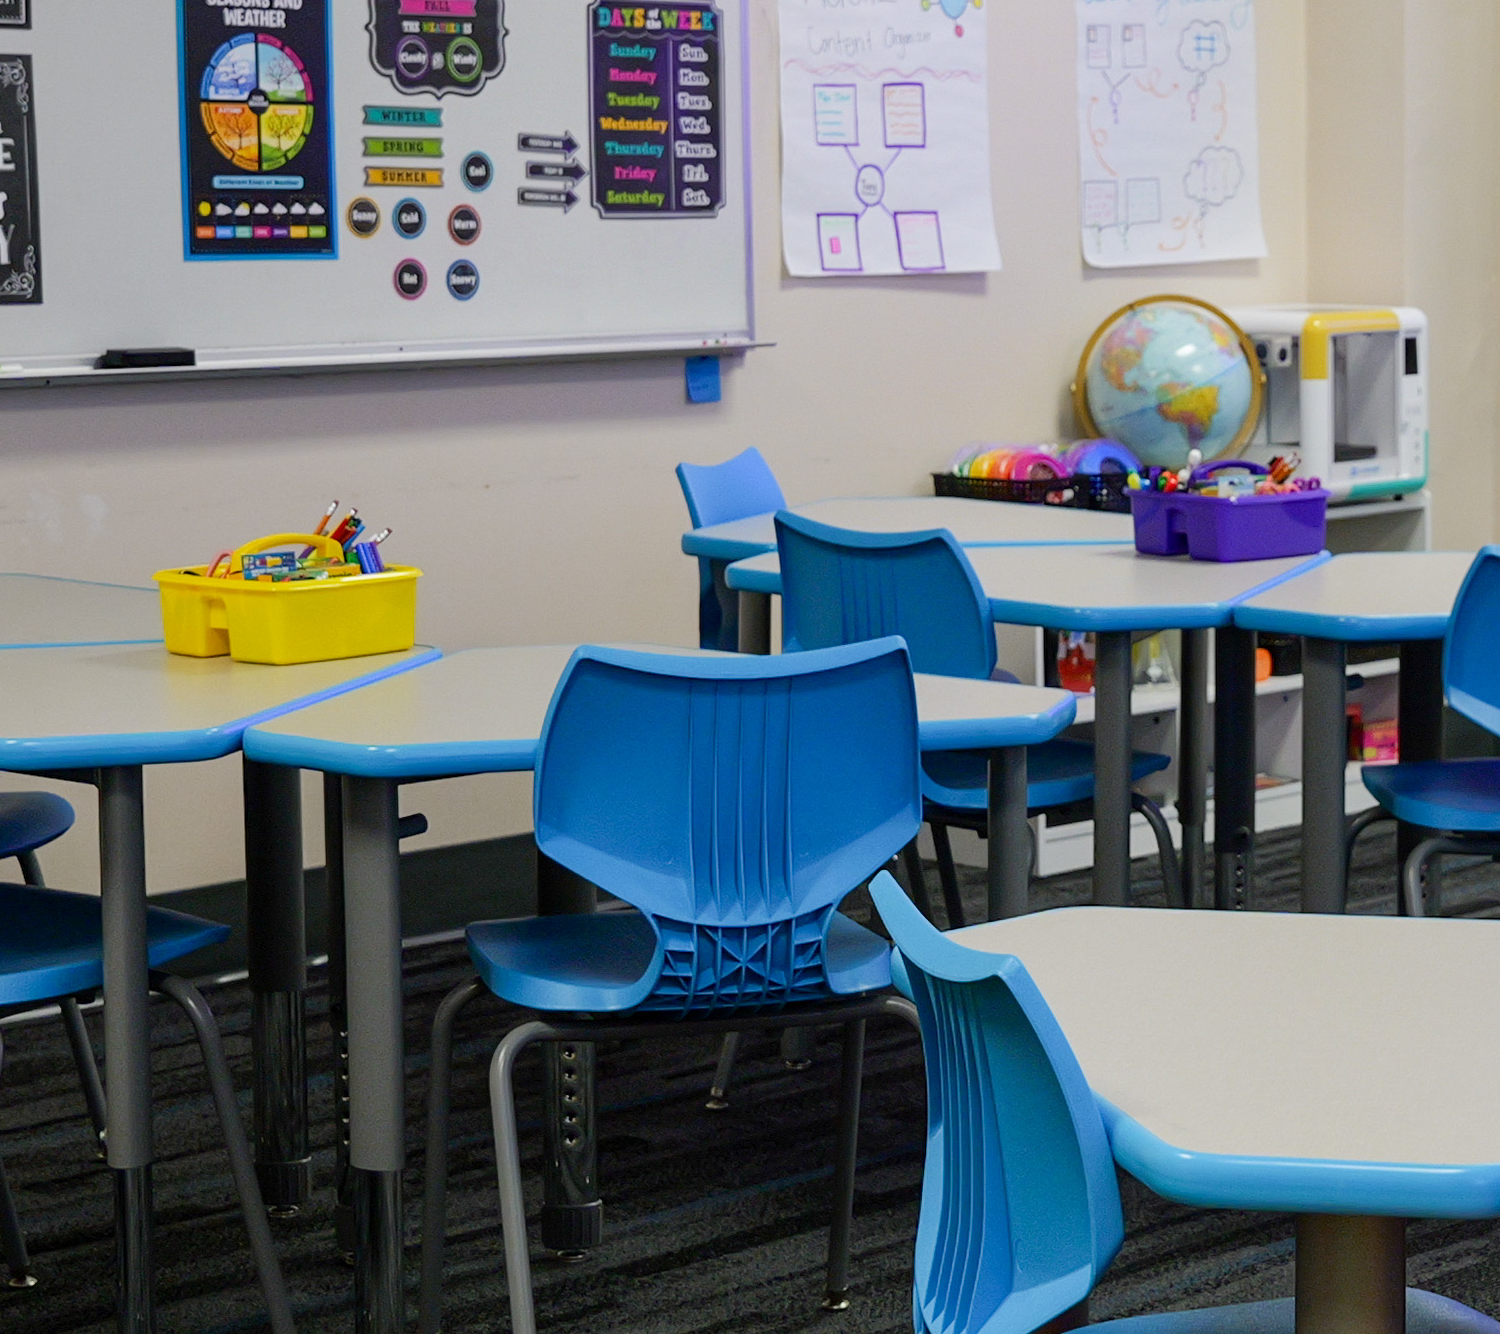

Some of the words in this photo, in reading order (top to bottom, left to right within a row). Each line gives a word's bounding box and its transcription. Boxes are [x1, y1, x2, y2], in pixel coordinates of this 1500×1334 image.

[222, 8, 286, 28] WEATHER
[597, 7, 645, 28] DAYS
[661, 10, 715, 31] WEEK
[609, 43, 656, 61] Sunday
[609, 68, 657, 85] Monday
[607, 92, 660, 110] Tuesday
[600, 116, 668, 134] Wednesday
[605, 141, 664, 158] Thursday
[614, 165, 657, 182] Friday
[607, 190, 664, 207] Saturday
